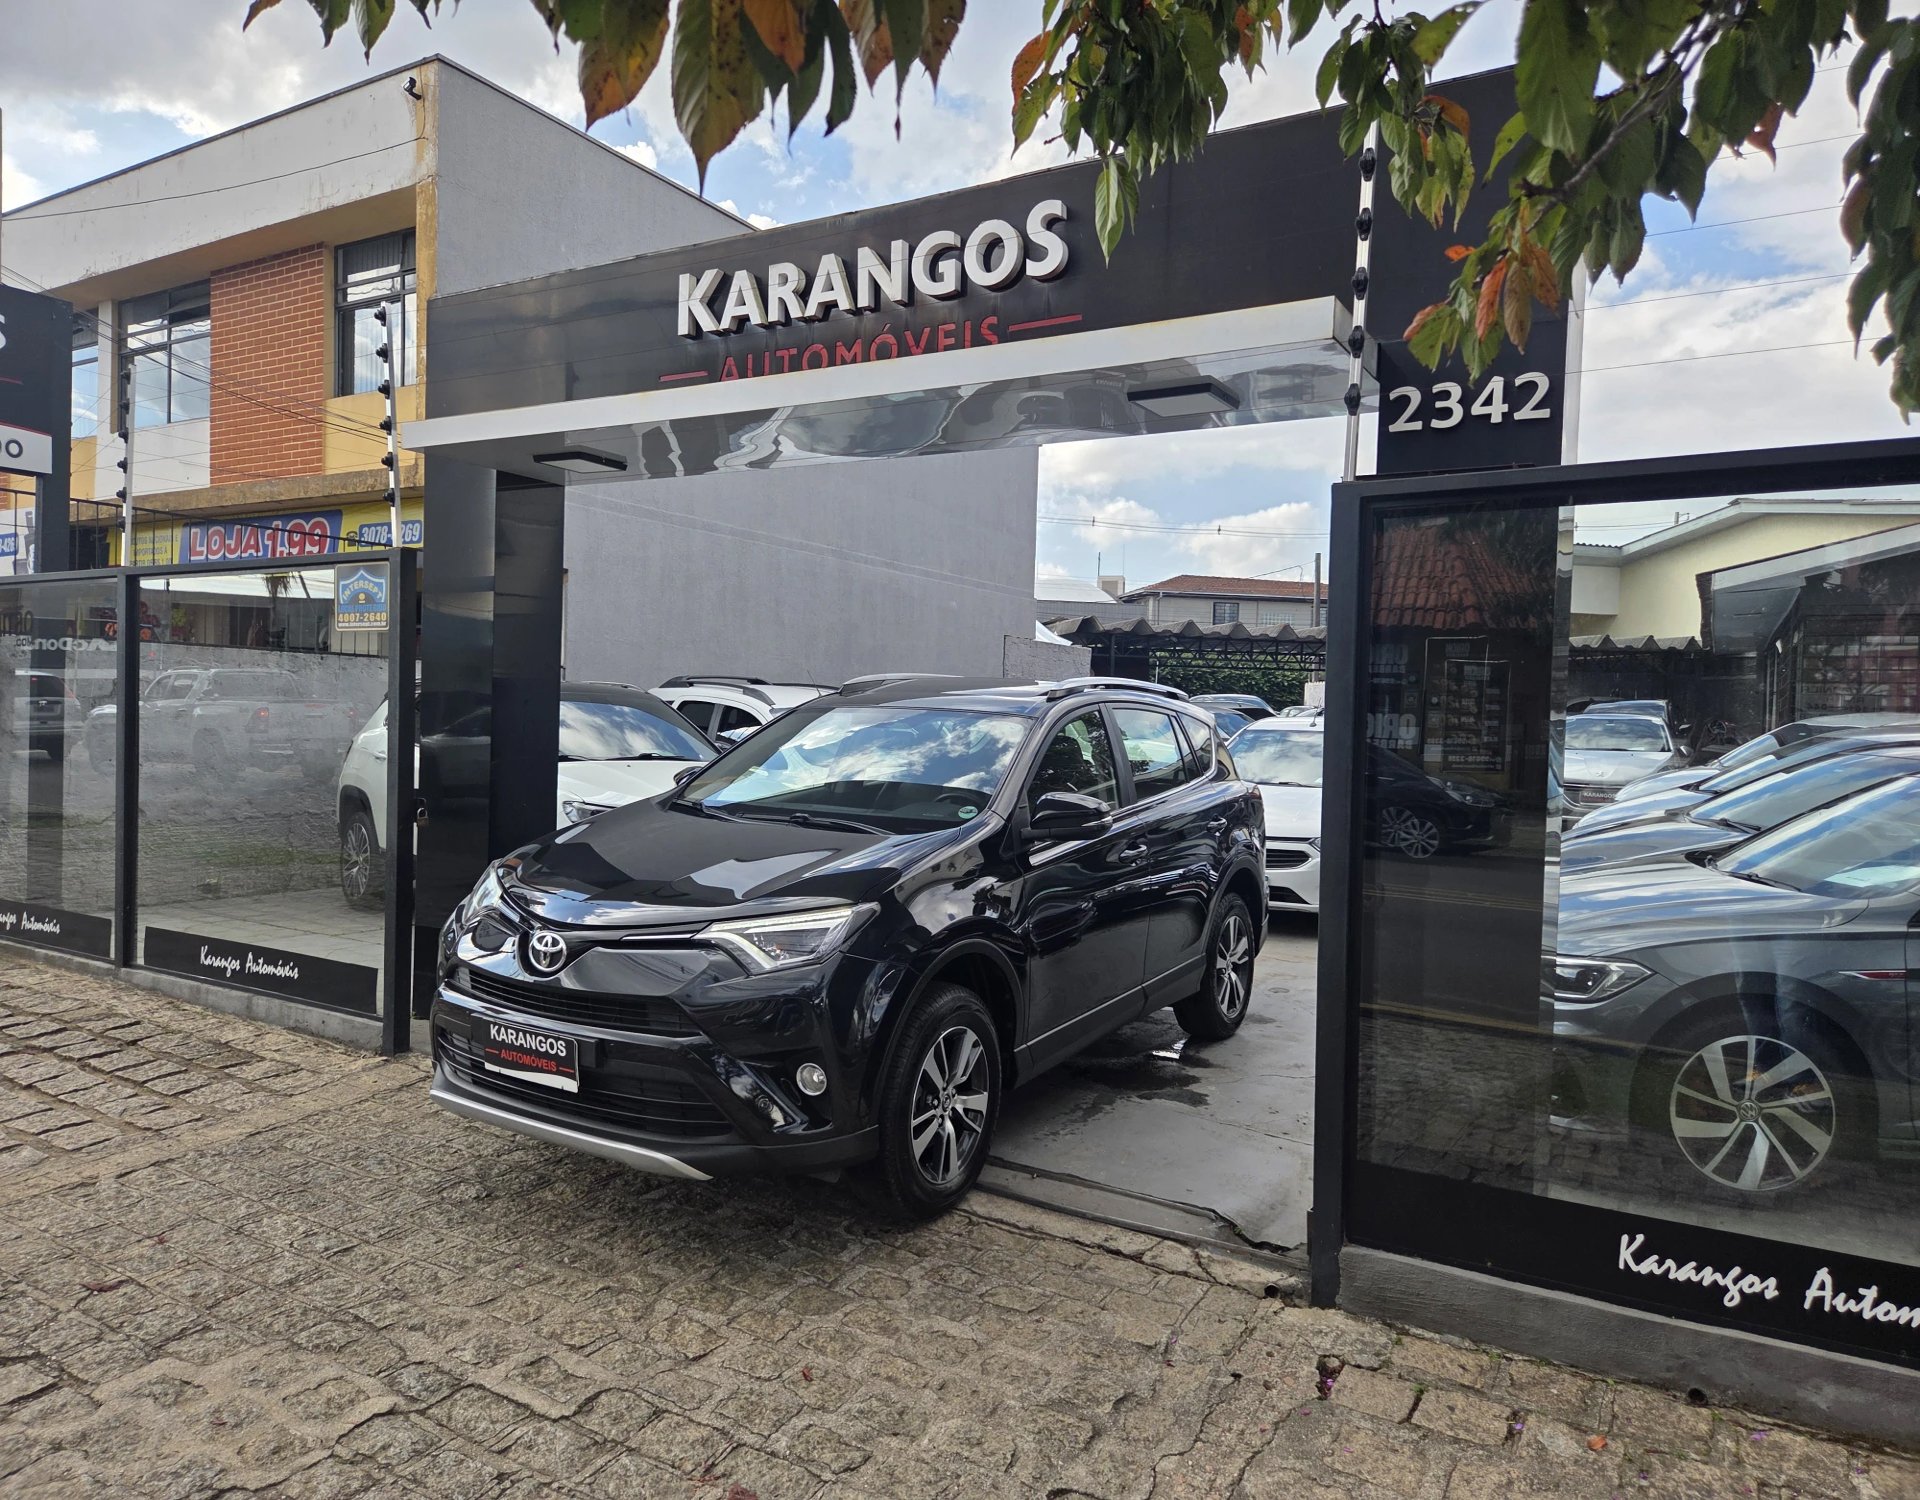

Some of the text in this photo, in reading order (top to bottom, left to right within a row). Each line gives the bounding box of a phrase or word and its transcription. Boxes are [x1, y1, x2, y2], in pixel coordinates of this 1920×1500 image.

[677, 199, 1070, 340] KARANGOS
[1388, 371, 1551, 433] 2342
[189, 524, 263, 562] LOJA
[361, 523, 420, 545] 3078-269
[342, 579, 383, 600] INTERSEPT
[338, 612, 388, 622] 4007-2640
[490, 1024, 567, 1057] KARANGOS
[500, 1049, 557, 1072] AUTOMÓVEIS
[1618, 1233, 1779, 1307] Karangos
